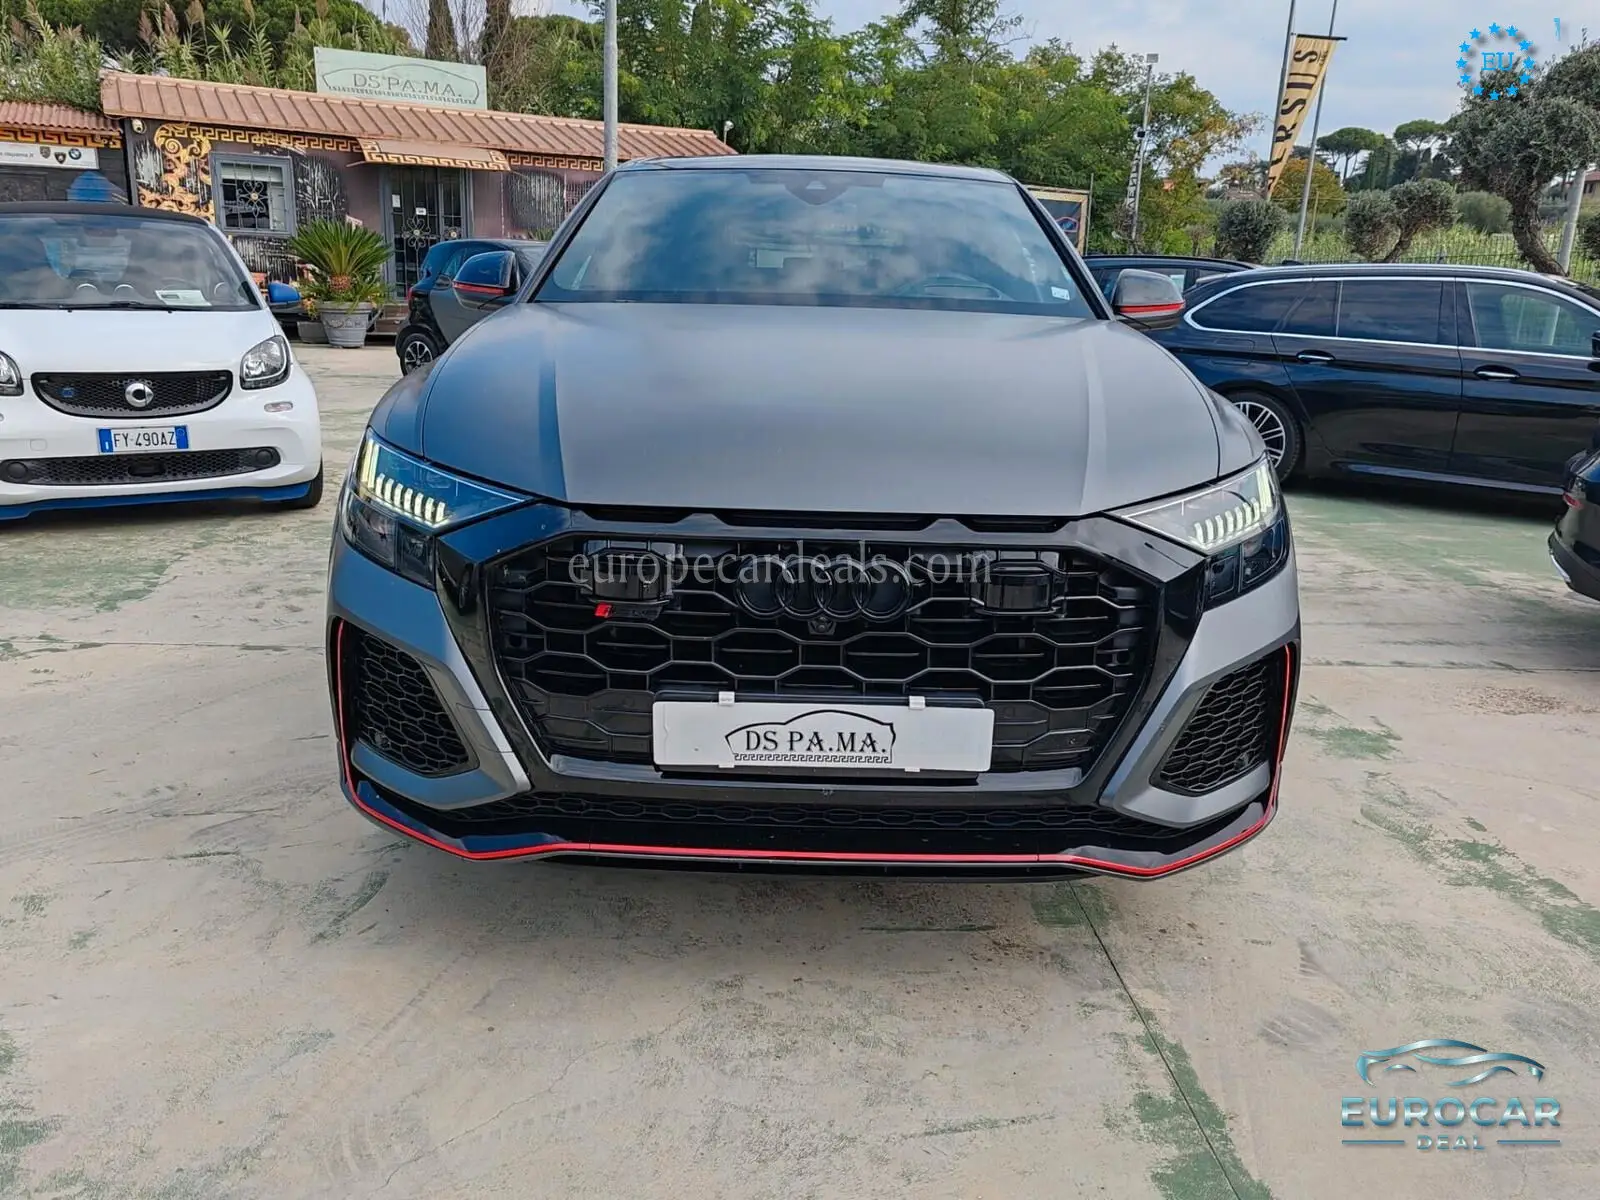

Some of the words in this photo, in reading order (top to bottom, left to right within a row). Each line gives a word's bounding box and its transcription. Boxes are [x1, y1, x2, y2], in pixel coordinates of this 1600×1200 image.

[353, 73, 381, 89] DS
[745, 730, 779, 752] DS
[787, 731, 887, 753] PA.MA.
